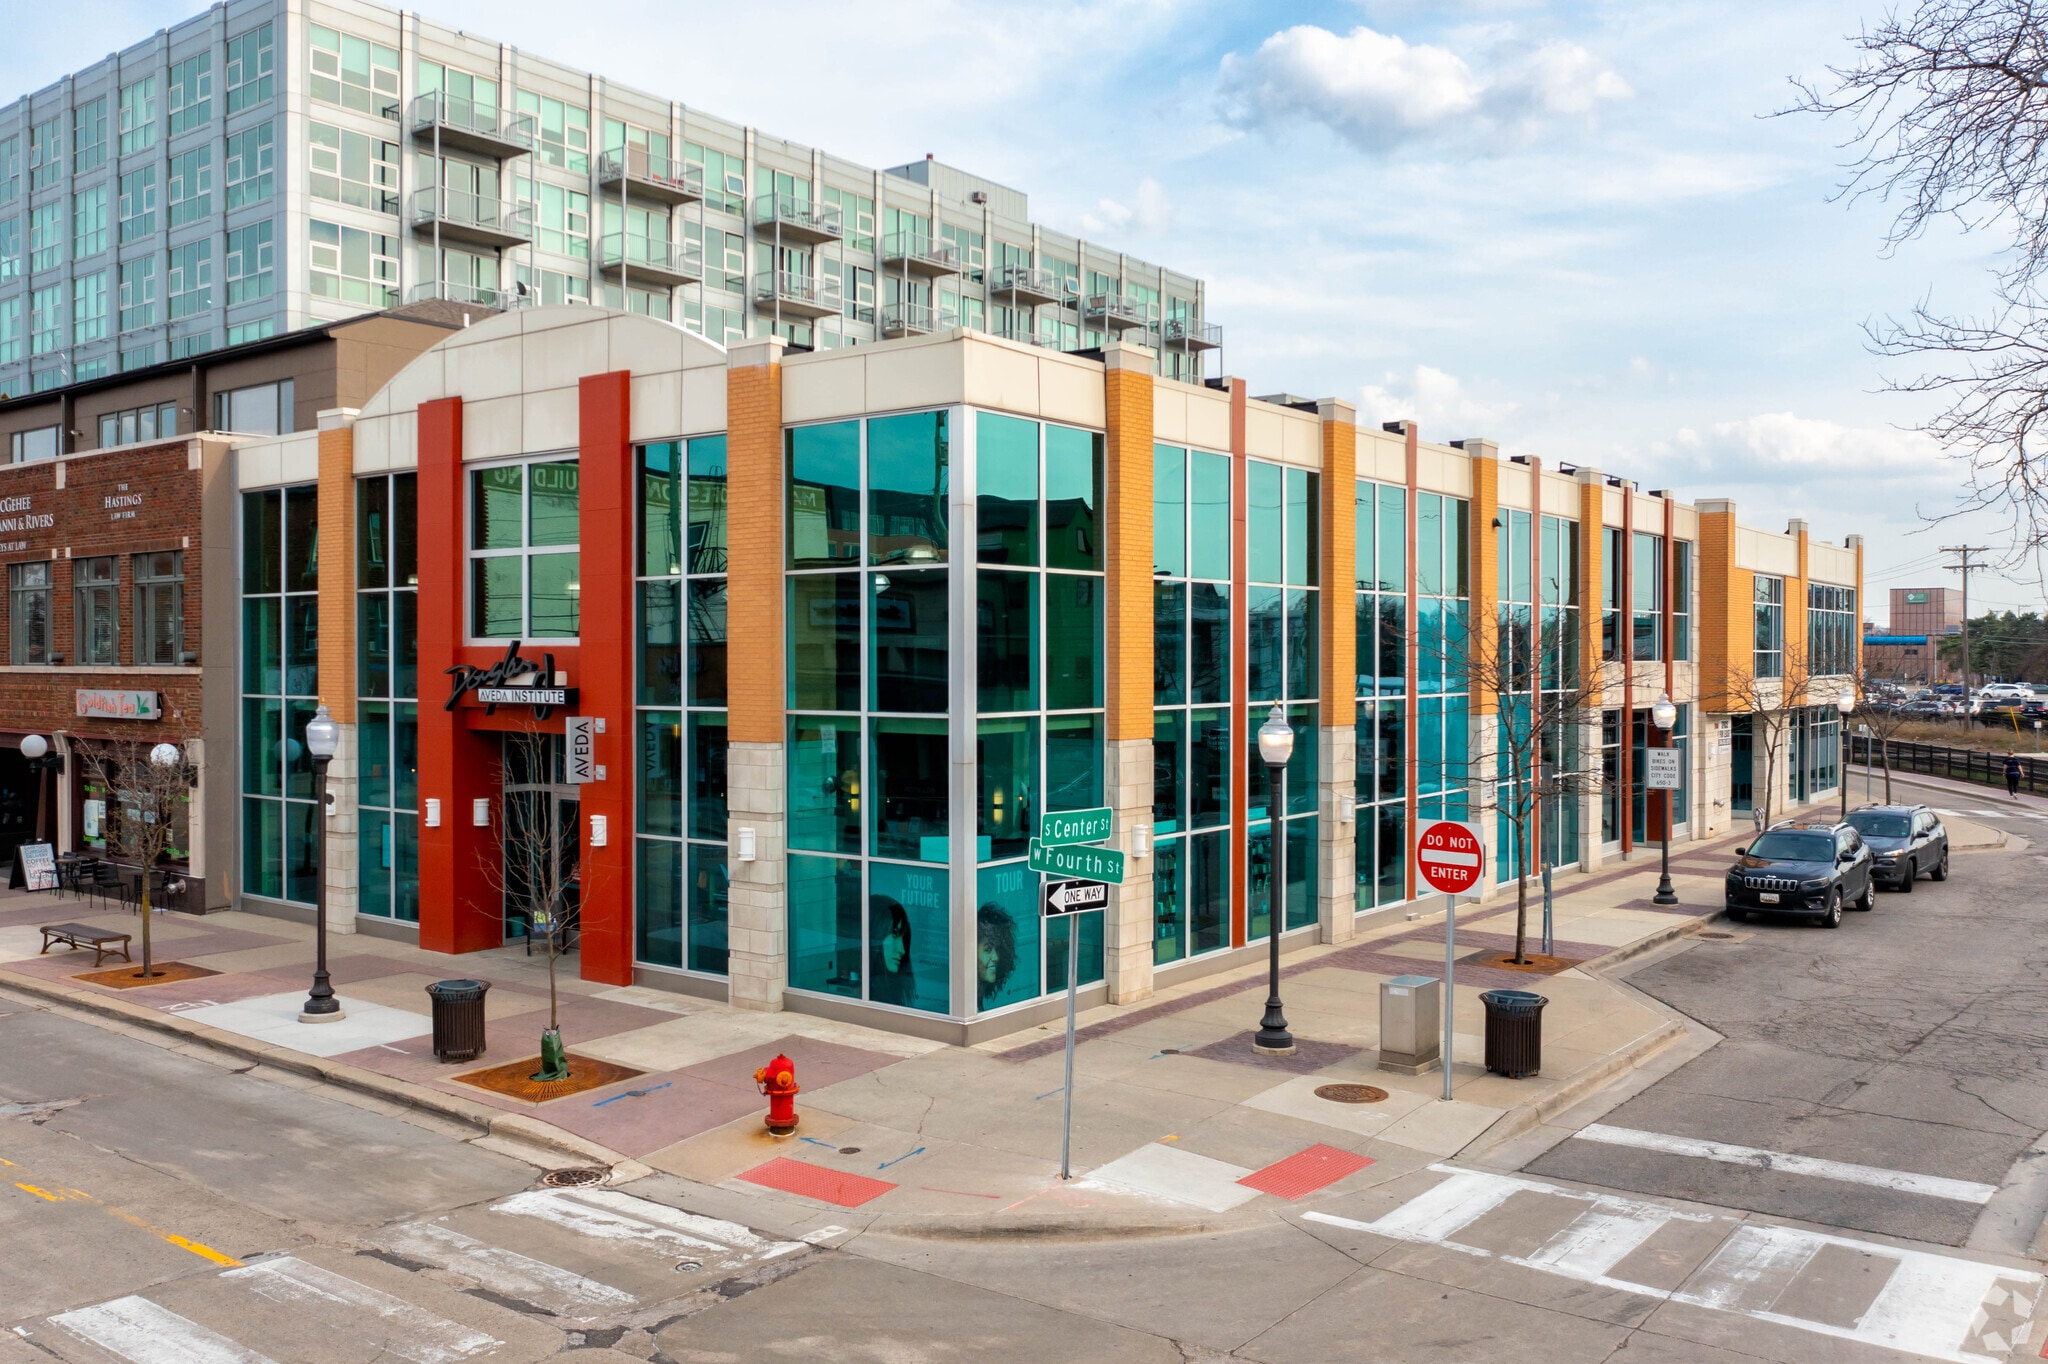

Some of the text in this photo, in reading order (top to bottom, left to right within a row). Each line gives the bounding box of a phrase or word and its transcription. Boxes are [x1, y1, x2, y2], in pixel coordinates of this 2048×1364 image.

[118, 483, 128, 491] THE
[105, 494, 142, 508] HASTINGS
[18, 518, 24, 530] &
[26, 514, 54, 529] RIVERS
[111, 511, 136, 520] LAW FIRM
[8, 542, 14, 551] AT
[15, 541, 27, 550] LAW
[480, 690, 564, 702] AVEDA INSTITUTE
[117, 693, 135, 716] Tea
[575, 721, 590, 778] AVEDA
[1045, 818, 1109, 838] S Center St
[1427, 834, 1473, 849] DO NOT
[1034, 847, 1119, 874] W Fourth St
[1431, 866, 1468, 880] ENTER
[907, 874, 933, 891] YOUR
[996, 870, 1023, 894] TOUR
[901, 889, 940, 909] FUTURE
[1064, 887, 1102, 903] ONE WAY
